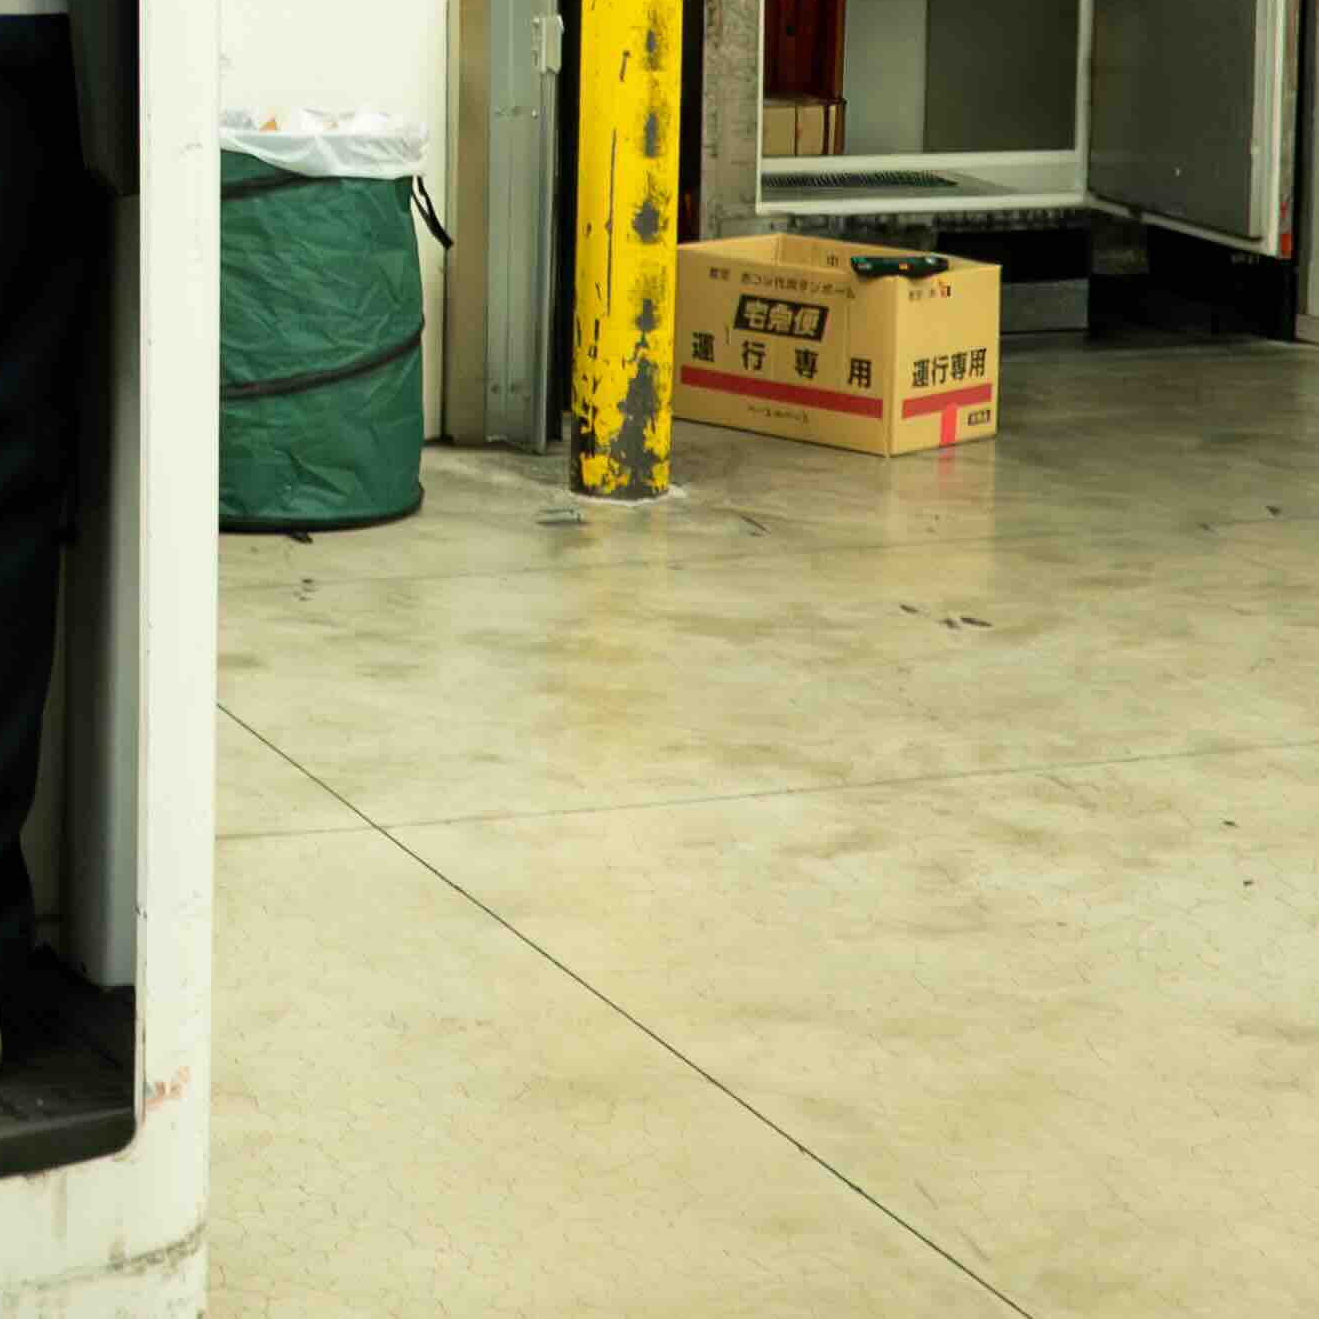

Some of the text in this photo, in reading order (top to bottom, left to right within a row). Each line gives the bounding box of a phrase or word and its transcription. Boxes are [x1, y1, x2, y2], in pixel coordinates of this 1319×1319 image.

[743, 299, 822, 337] 宅急便
[691, 331, 873, 389] 運行専用
[912, 348, 987, 387] 運行専用
